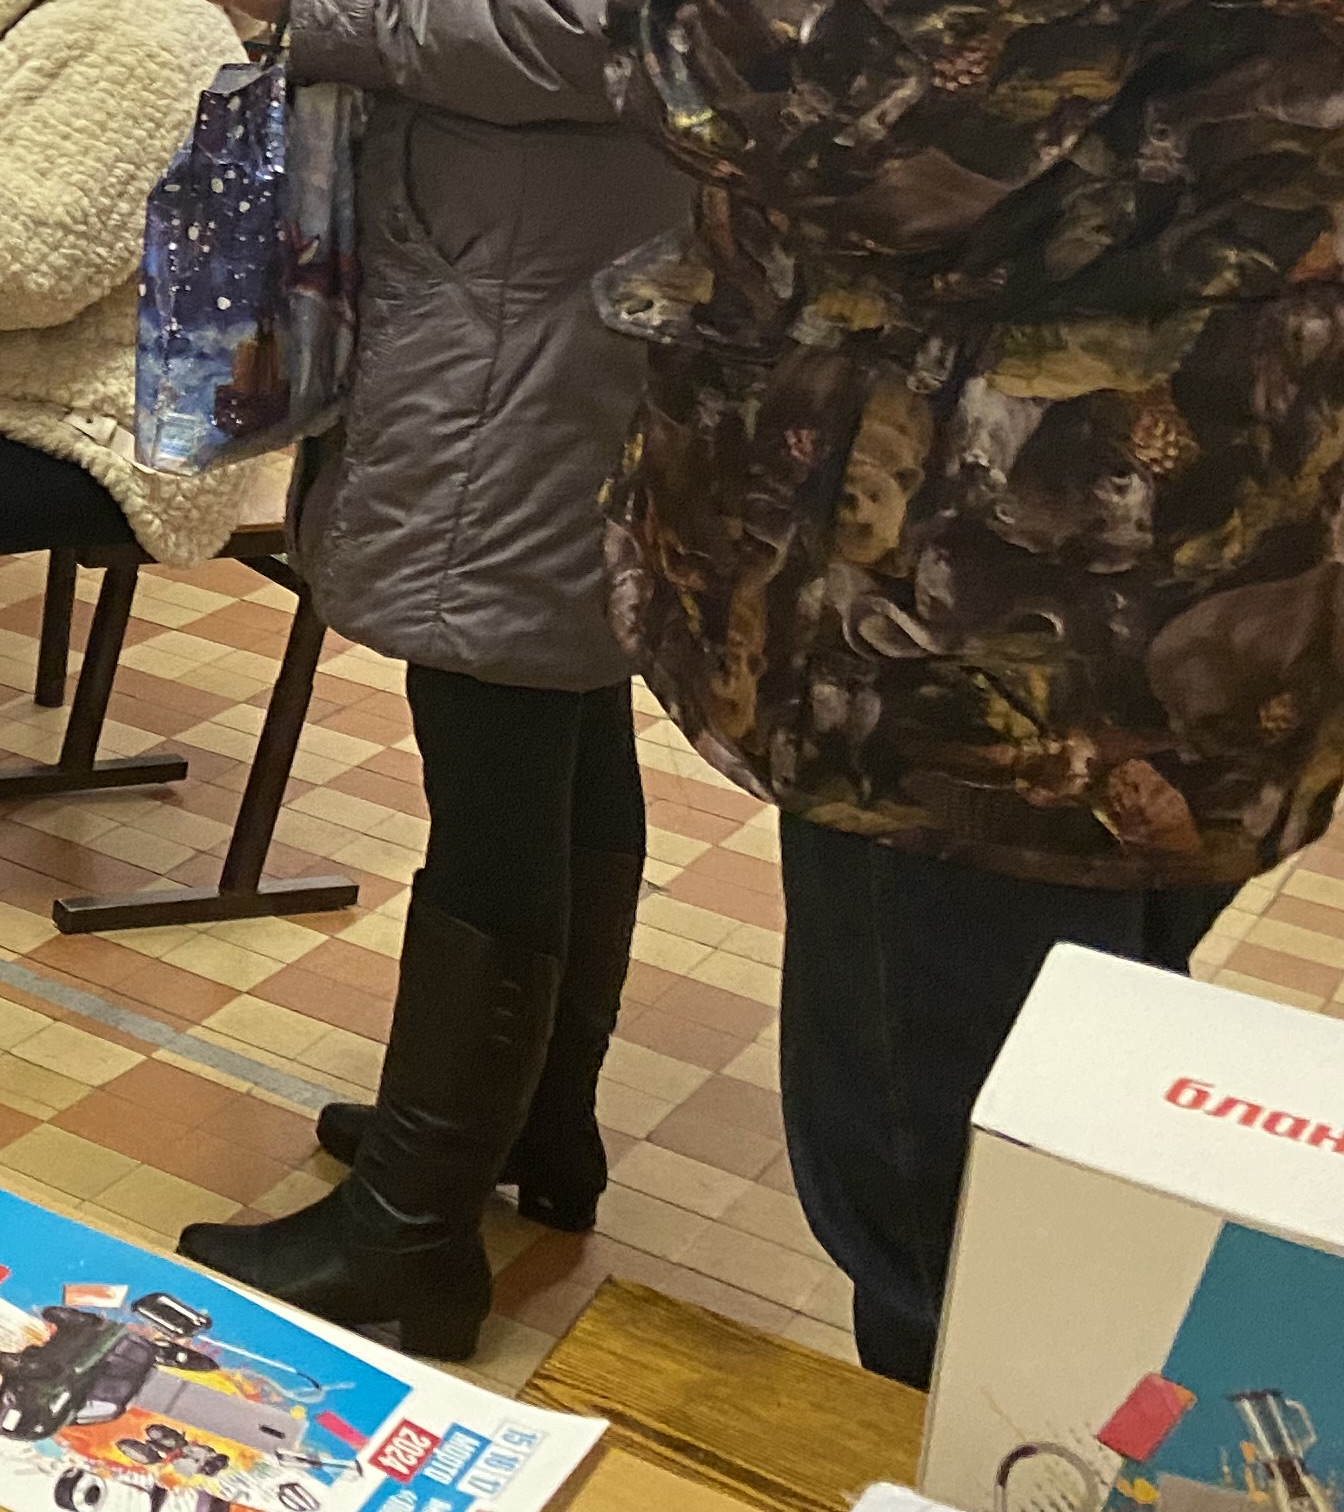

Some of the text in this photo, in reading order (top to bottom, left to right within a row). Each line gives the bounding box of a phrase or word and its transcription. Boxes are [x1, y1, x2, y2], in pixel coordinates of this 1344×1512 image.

[377, 1426, 432, 1476] 2024
[467, 1426, 538, 1494] 15 16 17
